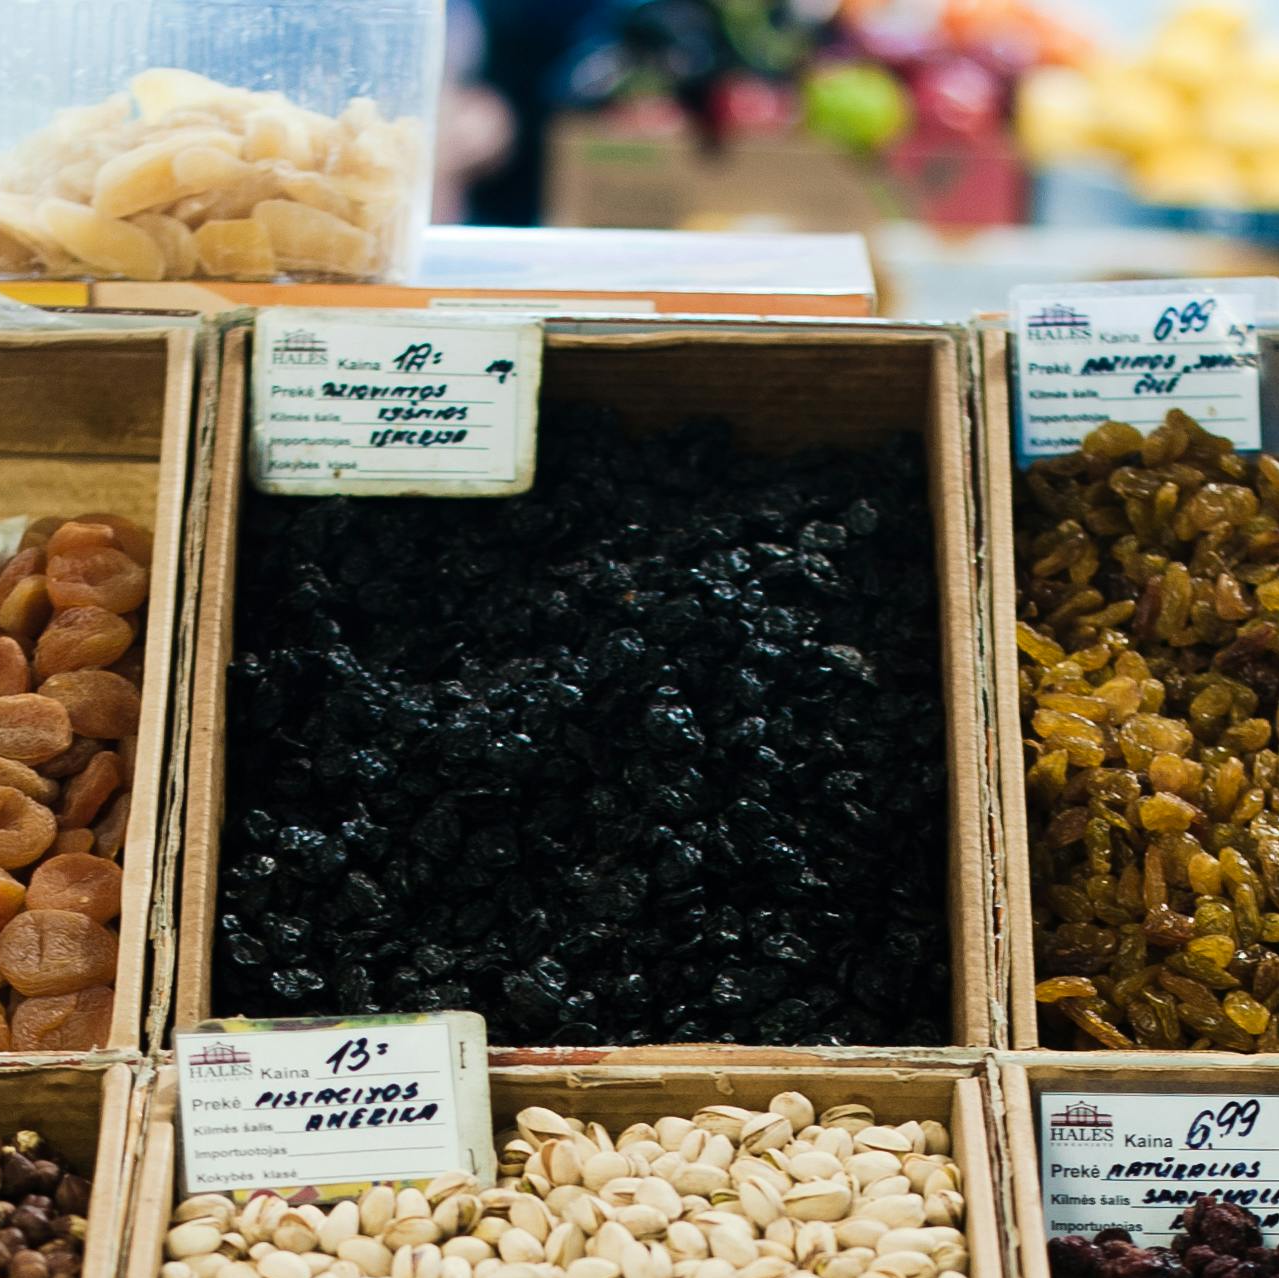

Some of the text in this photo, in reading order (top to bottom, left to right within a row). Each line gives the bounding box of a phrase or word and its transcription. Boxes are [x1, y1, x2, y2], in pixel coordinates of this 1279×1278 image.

[338, 358, 382, 372] Kaina
[271, 385, 315, 398] Prekė
[260, 1067, 310, 1081] Kaina
[191, 1081, 420, 1112] Prekė PISTACIJOS
[193, 1102, 440, 1137] Kilmės šalis AMERIKA
[1124, 1134, 1173, 1148] Kaina
[194, 1145, 289, 1160] Importuotojas
[196, 1169, 255, 1185] Kokybės
[1050, 1164, 1100, 1178] Prekė
[1050, 1193, 1096, 1206] Kilmės
[1100, 1192, 1131, 1206] šalis
